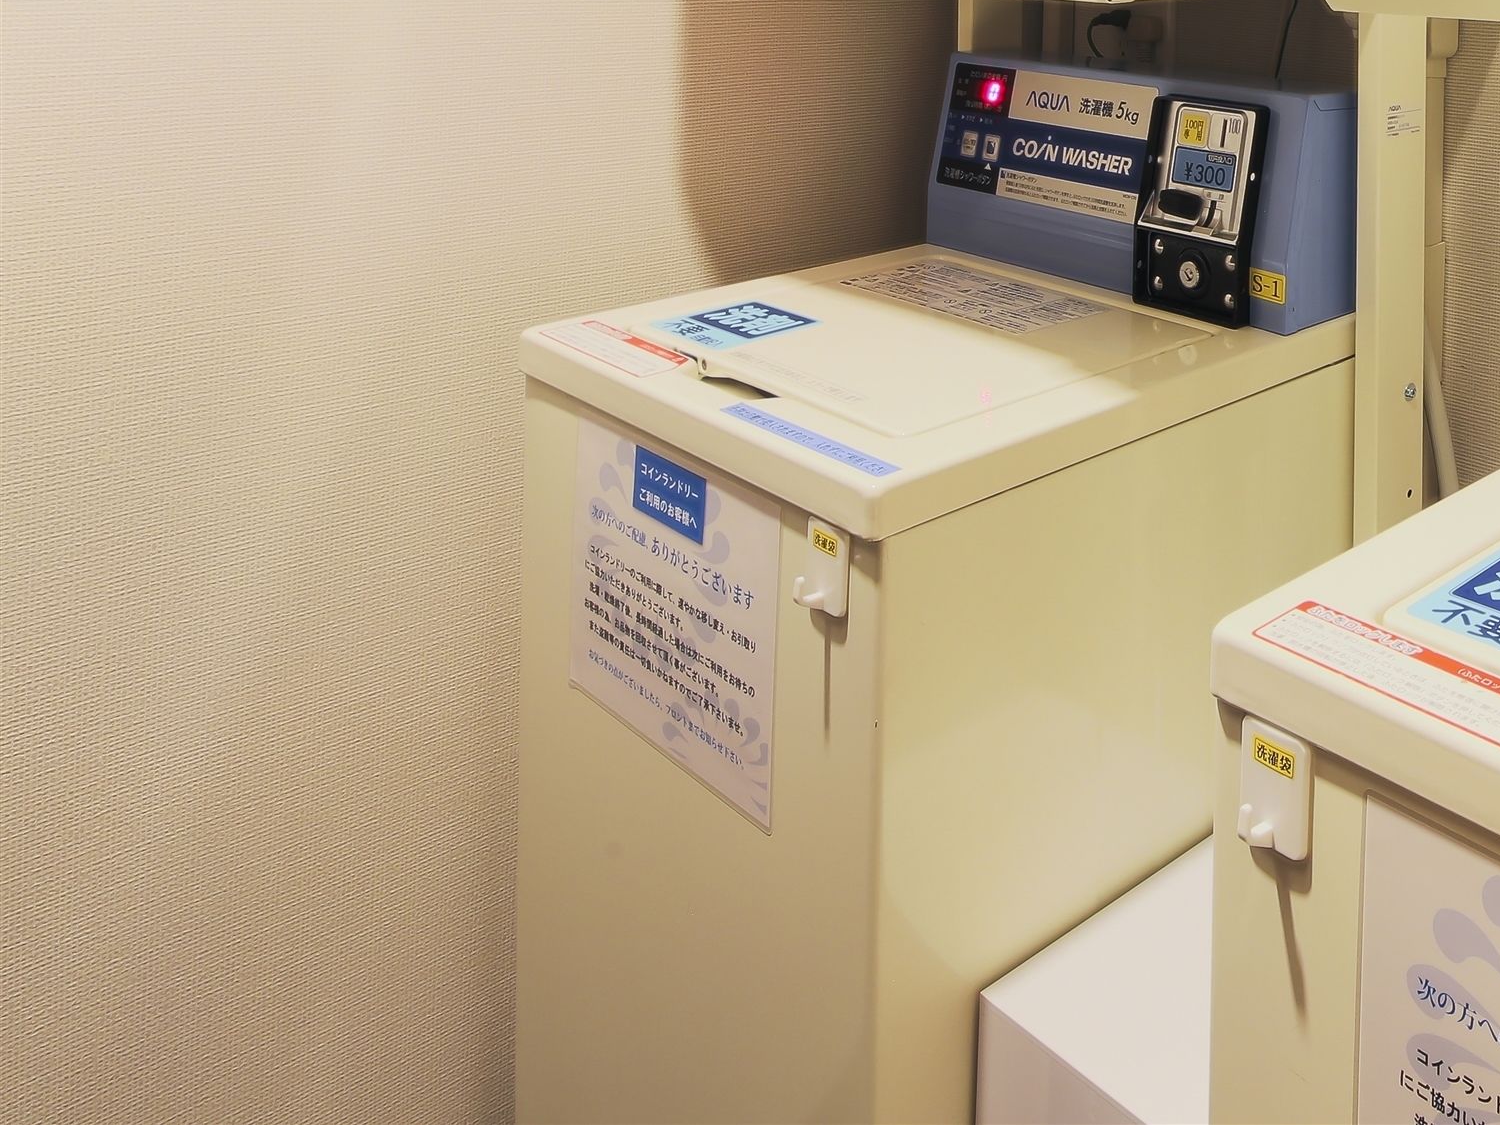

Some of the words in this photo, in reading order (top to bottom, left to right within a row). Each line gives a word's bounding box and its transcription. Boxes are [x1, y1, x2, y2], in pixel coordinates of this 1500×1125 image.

[1026, 90, 1071, 113] AQUA
[1079, 97, 1114, 119] 洗濯機
[1115, 101, 1140, 125] 5kg
[1184, 118, 1205, 132] 100円
[1061, 146, 1133, 176] WASHER
[1183, 161, 1227, 188] ¥300
[1251, 274, 1281, 299] S-1
[640, 461, 699, 500] コインランドリー
[639, 486, 698, 530] ご利用のお客様へ
[813, 529, 837, 556] 洗濯袋
[1255, 741, 1294, 777] 洗濯袋
[1399, 1069, 1486, 1125] にご協力い
